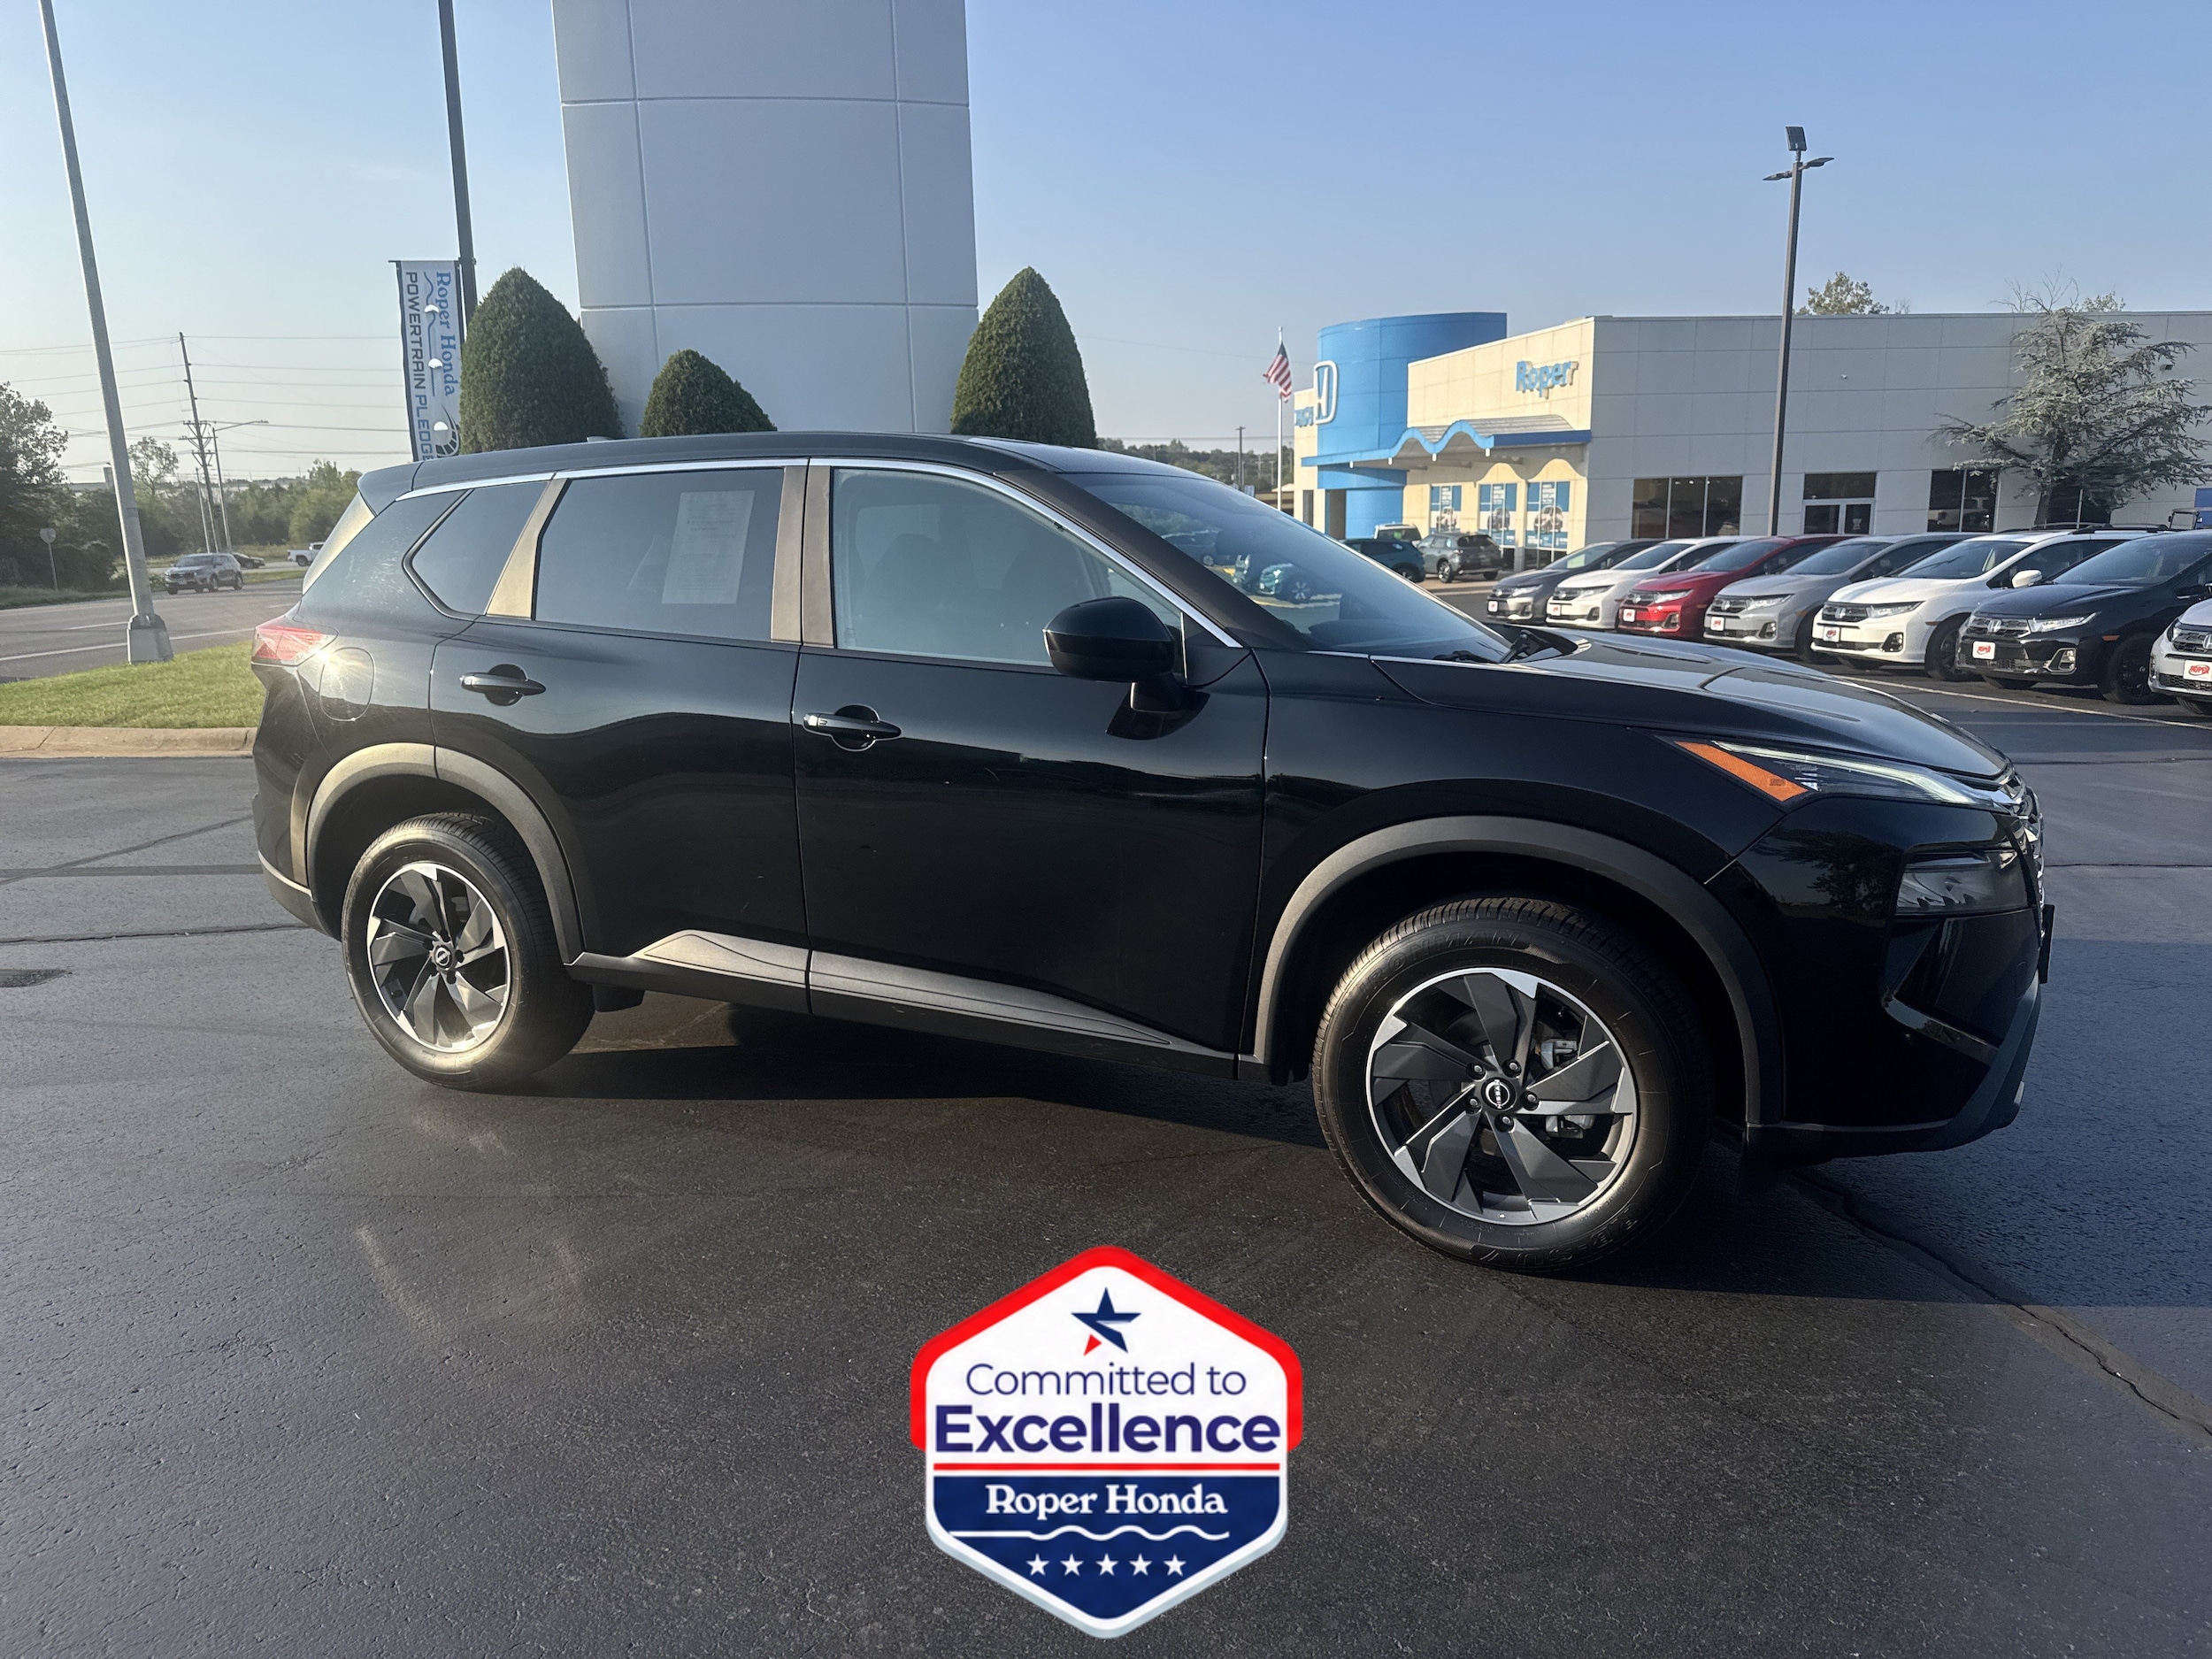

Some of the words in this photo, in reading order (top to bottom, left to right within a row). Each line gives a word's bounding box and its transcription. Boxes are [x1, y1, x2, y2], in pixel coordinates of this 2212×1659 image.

[406, 272, 426, 389] POWERTRAIN
[435, 272, 452, 329] Roper
[441, 334, 460, 396] Honda
[1516, 360, 1579, 399] Roper
[1359, 929, 1521, 1000] IRONMAN
